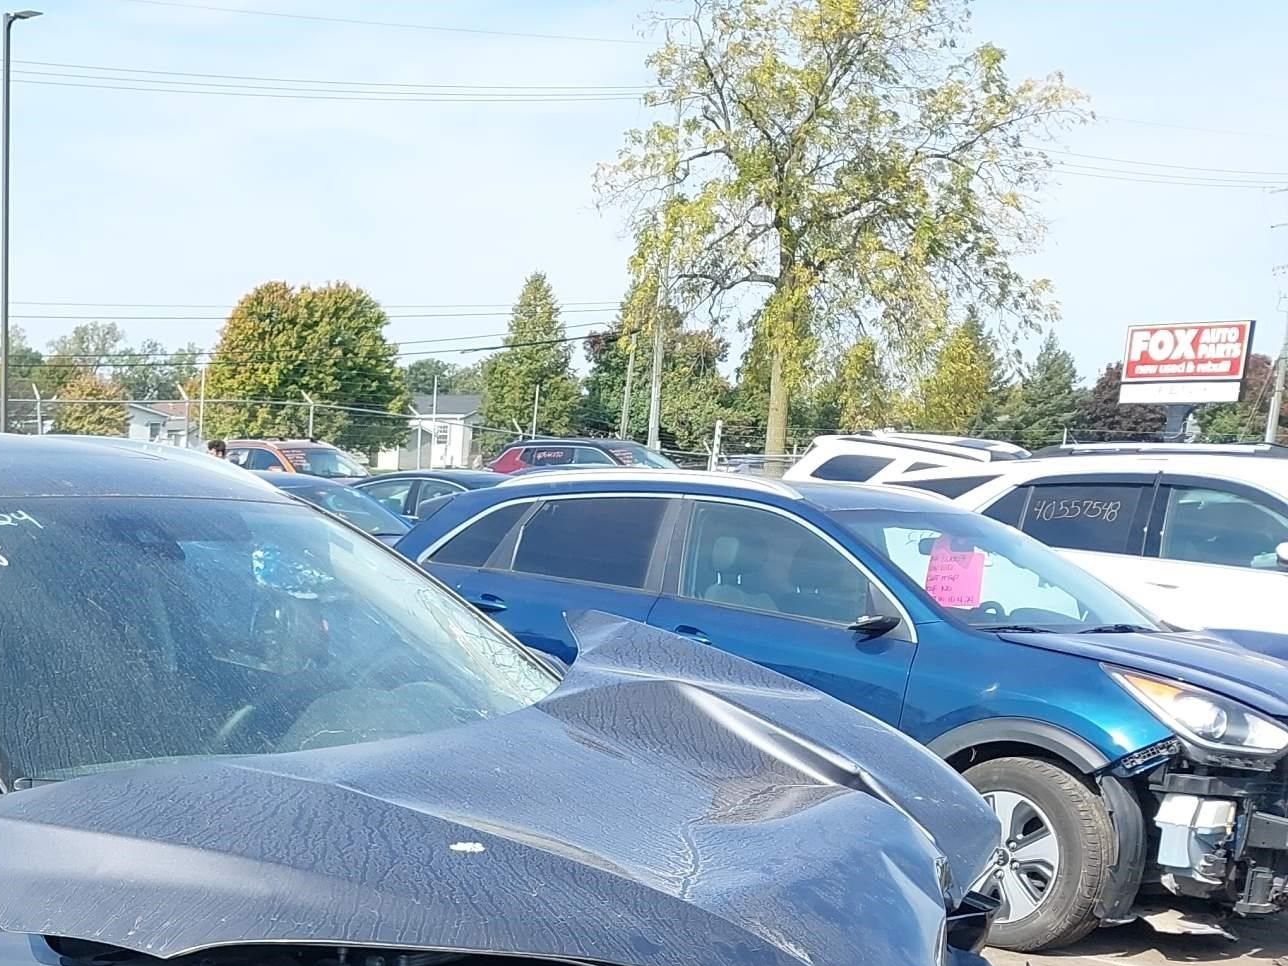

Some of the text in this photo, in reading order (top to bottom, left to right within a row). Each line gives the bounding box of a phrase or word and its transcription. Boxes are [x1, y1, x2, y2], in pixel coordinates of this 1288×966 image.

[1130, 328, 1199, 362] FOX
[1198, 327, 1239, 343] AUTO
[1197, 342, 1242, 359] PARTS
[1033, 499, 1121, 522] 40557548
